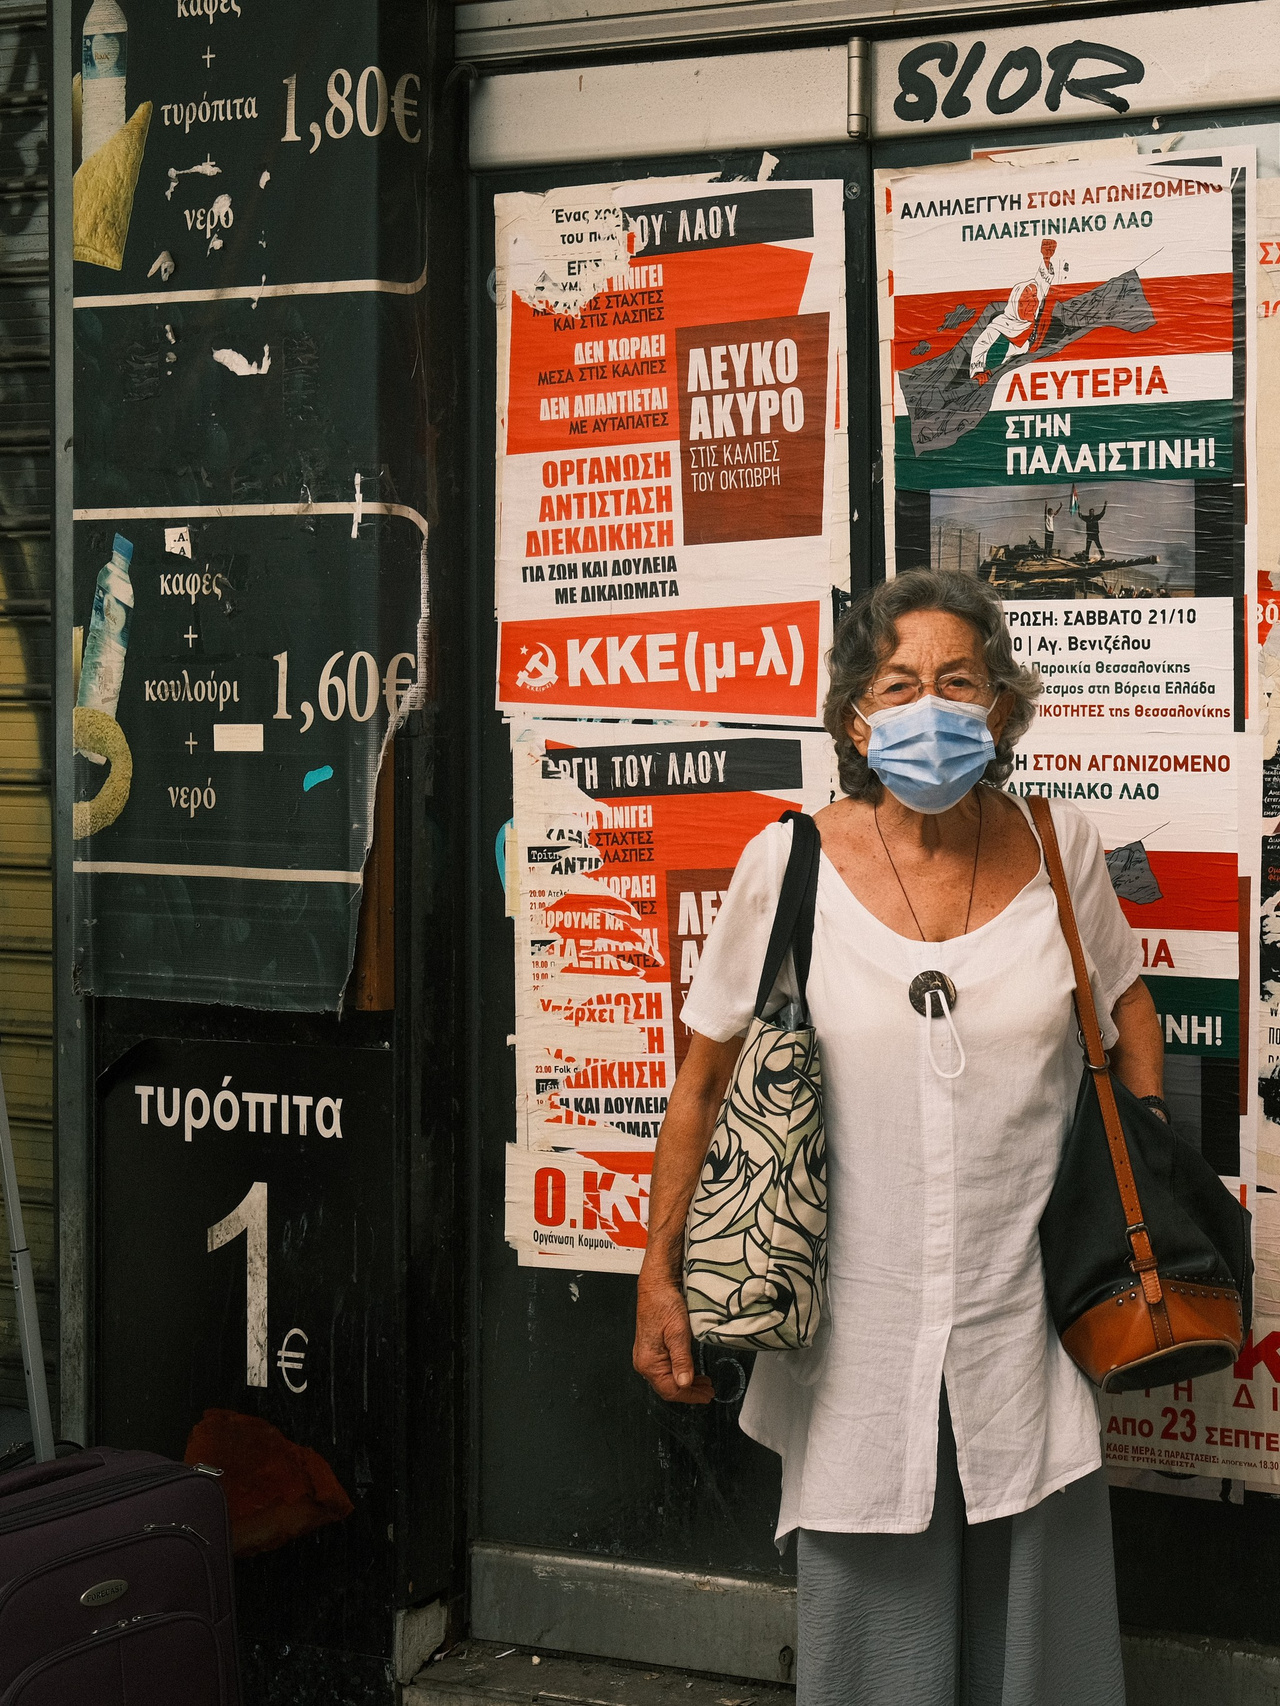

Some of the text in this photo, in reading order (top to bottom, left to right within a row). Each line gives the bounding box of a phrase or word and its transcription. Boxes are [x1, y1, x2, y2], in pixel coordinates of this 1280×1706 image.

[160, 91, 258, 134] τυρόπιτα
[281, 65, 422, 154] 1,80€
[677, 205, 738, 244] ΛΑΟΥ
[605, 290, 663, 309] ΣΤΑΧΤΕΣ
[554, 307, 665, 332] ΚΑΙ ΣΤΙΣ ΛΑΣΠΕΣ
[574, 334, 666, 366] ΔΕΝ ΧΩΡΑΕΙ
[687, 339, 799, 393] ΛΕΥΚΟ
[537, 360, 667, 387] ΜΕΣΑ ΣΤΙΣ ΚΑΛΠΕΣ
[1005, 365, 1169, 403] ΛΕΥΤΕΡΙΑ
[539, 387, 668, 422] ΔΕΝ ΑΠΑΝΤΙΕΤΑΙ
[689, 387, 805, 441] ΑΚΥΡΟ
[569, 412, 669, 436] ΜΕ ΑΥΤΑΠΑΤΕΣ
[1005, 413, 1071, 439] ΣΤΗΝ
[542, 451, 672, 489] ΟΡΓΑΝΩΣΗ
[690, 440, 780, 471] ΣΤΙΣ ΚΑΛΠΕΣ
[1006, 437, 1216, 475] ΠΑΛΑΙΣΤΙΝΗ!
[691, 466, 781, 493] ΤΟΥ ΟΚΤΩΒΡΗ
[538, 485, 673, 523] ΑΝΤΙΣΤΑΣΗ
[525, 520, 674, 558] ΔΙΕΚΔΙΚΗΣΗ
[160, 564, 223, 605] καφές
[521, 555, 677, 583] ΓΙΑ ΖΩΗ ΚΑΙ ΔΟΥΛΕΙΑ
[555, 579, 679, 605] ΜΕ ΔΙΚΑΙΩΜΑΤΑ
[566, 624, 804, 694] ΚΚΕ(μ-λ)
[144, 670, 239, 712] κουλούρι
[612, 750, 727, 787] ΤΟΥ ΛΑΟΥ
[168, 778, 216, 818] νερό
[535, 1065, 571, 1074] 23.00 Folk
[134, 1076, 343, 1142] τυρόπιτα
[533, 1230, 575, 1249] Οργάνωση
[207, 1182, 268, 1387] 1
[1106, 1415, 1154, 1438] ΑΠΟ
[1160, 1406, 1197, 1442] 23
[1106, 1442, 1129, 1454] ΚΑΘΕ
[1131, 1445, 1156, 1457] ΜΕΡΑ
[1259, 1460, 1279, 1471] 18.30
[87, 1584, 124, 1602] FORECAST
